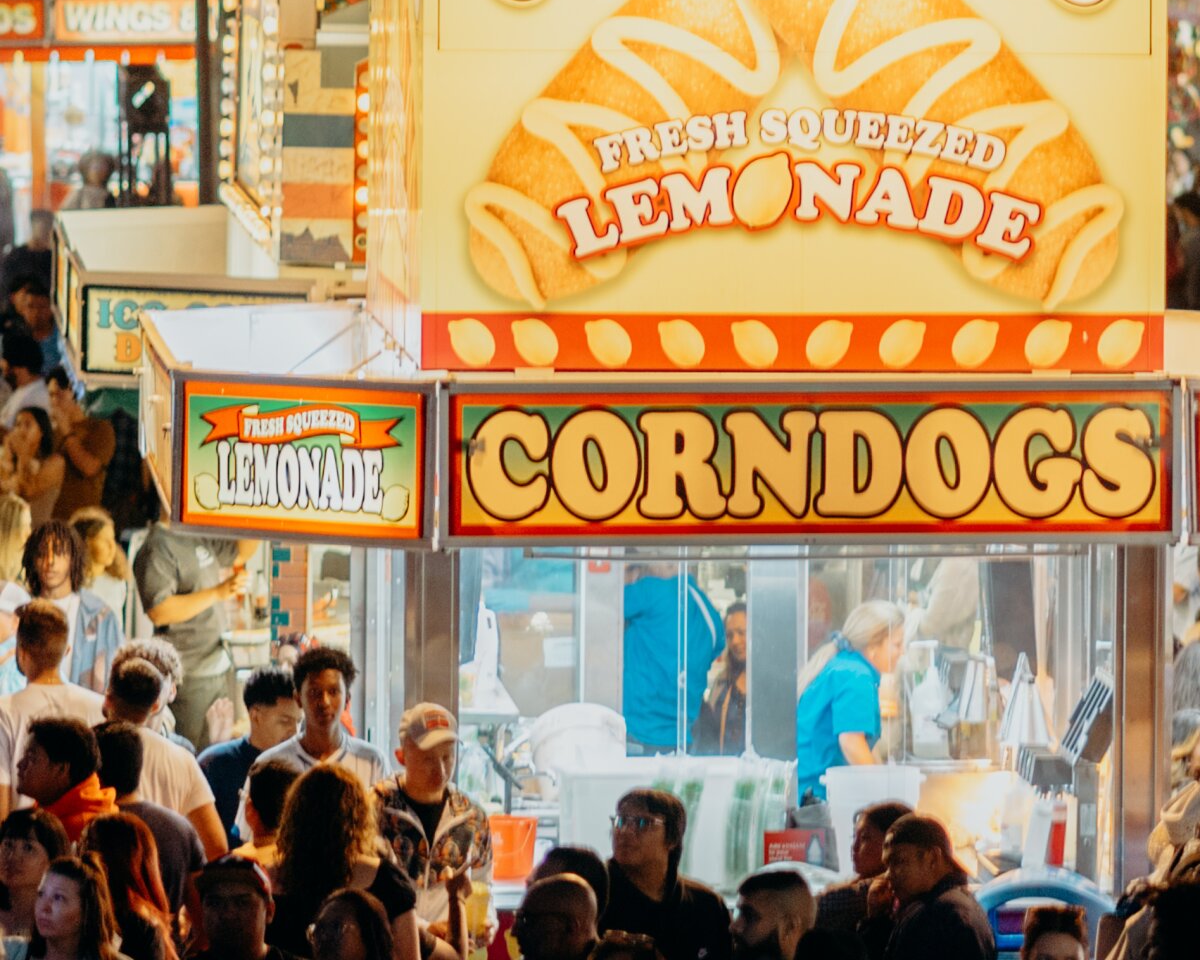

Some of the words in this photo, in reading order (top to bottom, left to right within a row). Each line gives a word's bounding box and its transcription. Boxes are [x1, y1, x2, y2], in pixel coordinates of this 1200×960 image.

[63, 1, 172, 33] WINGS
[592, 109, 748, 174] FRESH
[759, 107, 1008, 172] SQUEEZED
[243, 416, 285, 438] FRESH
[286, 408, 356, 437] SQUEEZED
[215, 439, 385, 515] LEMONADE
[466, 406, 1157, 520] CORNDOGS
